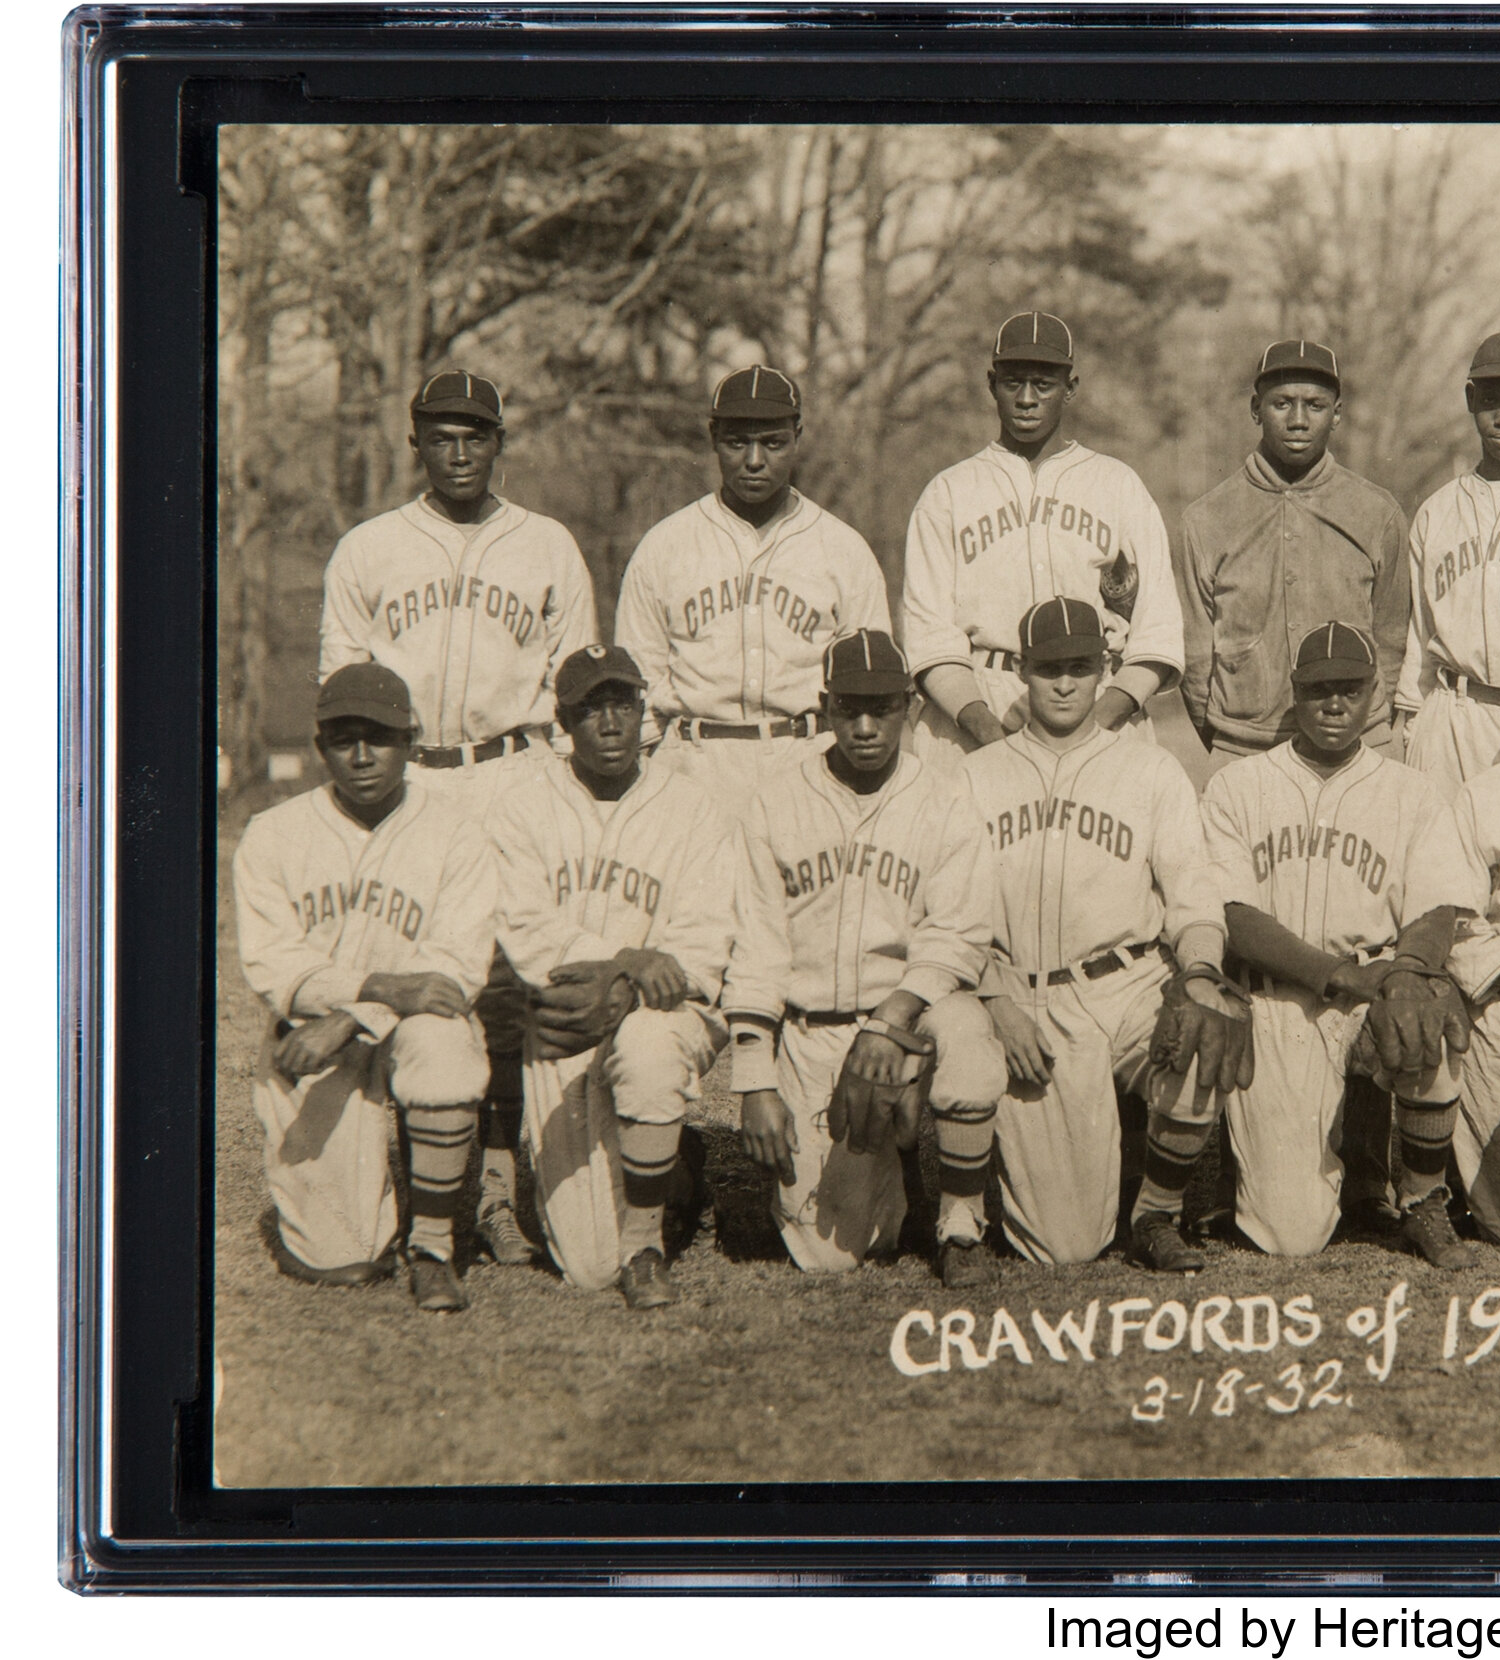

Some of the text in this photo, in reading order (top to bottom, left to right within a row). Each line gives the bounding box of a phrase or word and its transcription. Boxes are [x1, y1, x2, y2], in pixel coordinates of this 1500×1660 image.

[966, 496, 1112, 565] CRAWFORD
[386, 574, 534, 648] CRAWFORD
[684, 572, 821, 644] CRAWFORD
[986, 797, 1134, 862] RAWFORD
[890, 1295, 1322, 1377] CRAWFORDS
[1346, 1283, 1412, 1382] of
